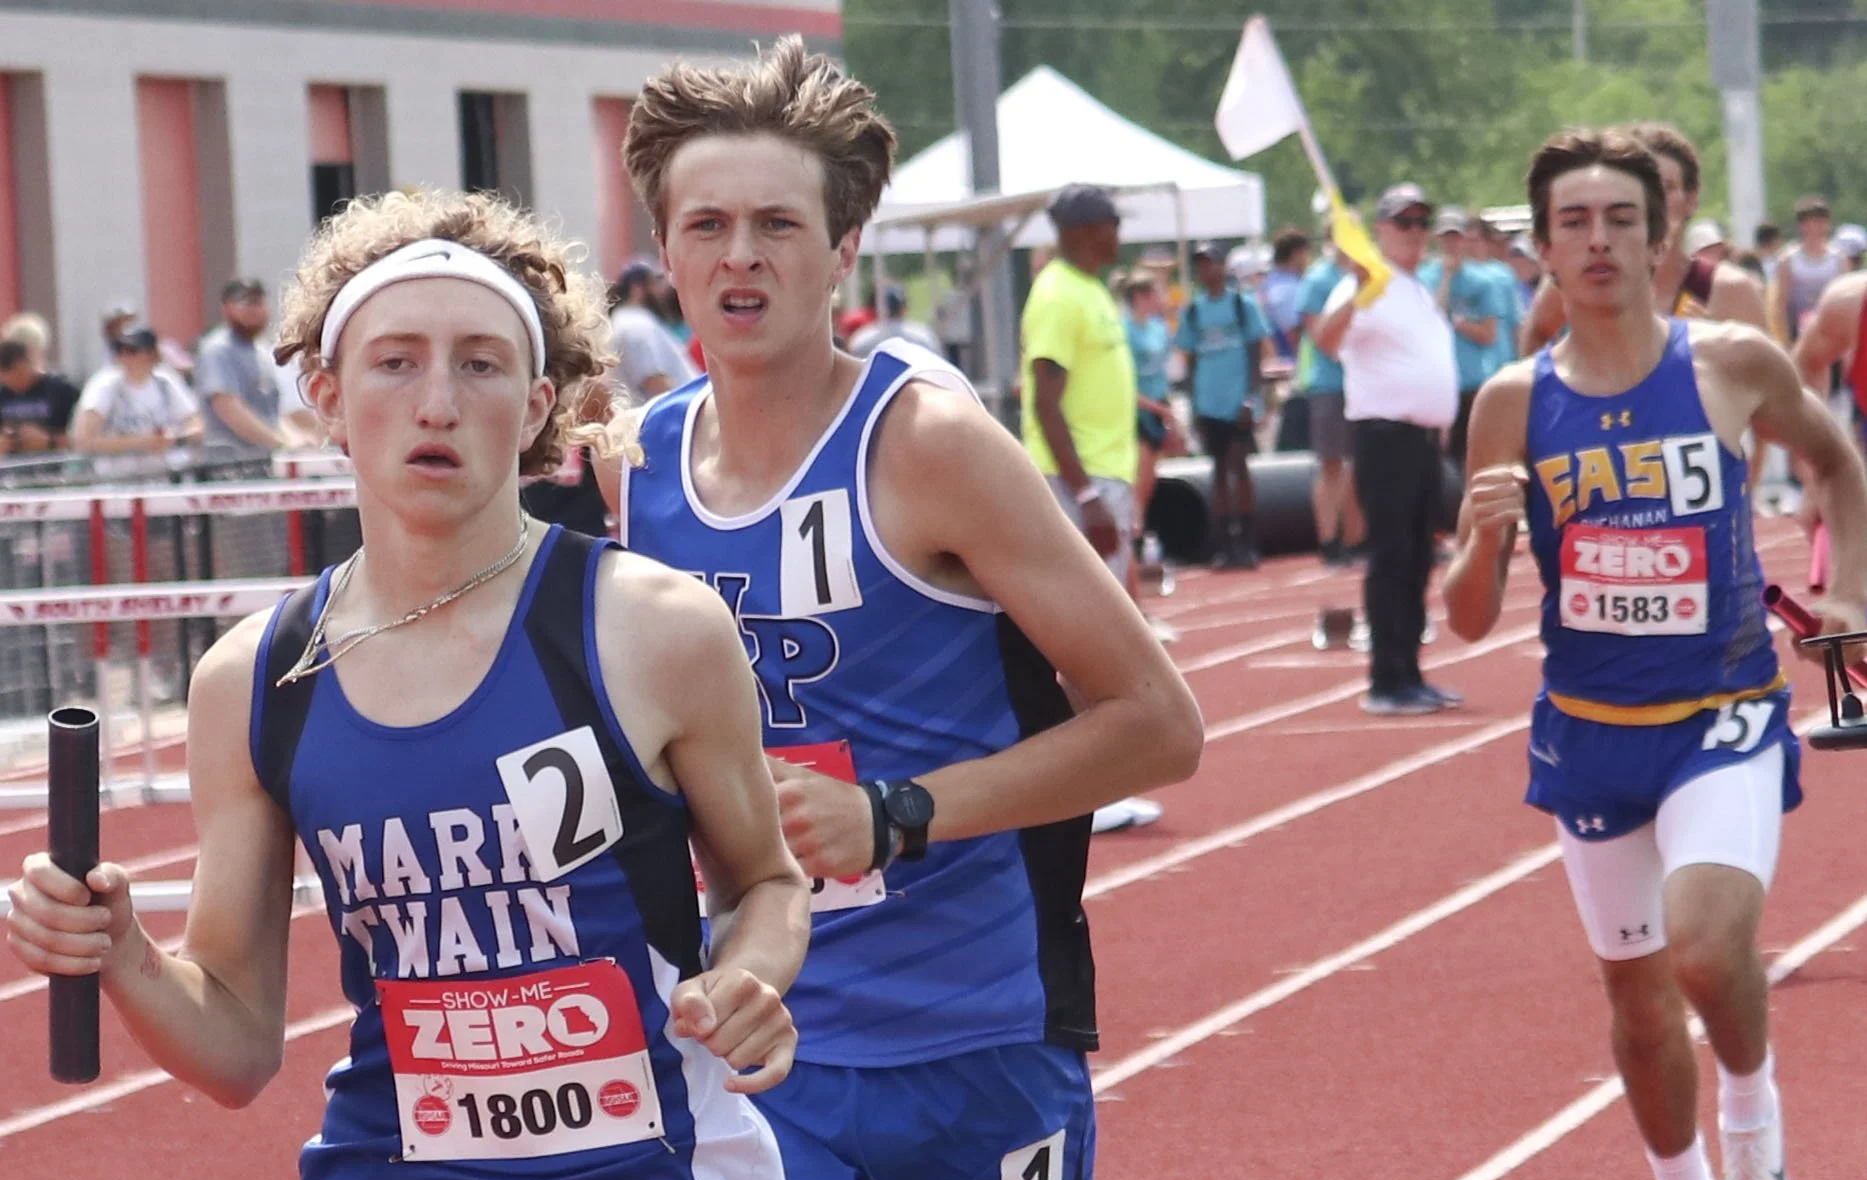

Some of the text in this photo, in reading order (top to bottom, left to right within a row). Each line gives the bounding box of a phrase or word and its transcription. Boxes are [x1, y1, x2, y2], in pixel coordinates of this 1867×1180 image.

[1535, 440, 1667, 529] EAS
[1678, 442, 1711, 508] 5
[799, 500, 832, 604] 1
[1573, 541, 1692, 577] ZERO
[1596, 594, 1668, 623] 1583
[522, 747, 607, 868] 2
[341, 885, 580, 978] TWAIN
[402, 993, 610, 1061] ZERO
[442, 981, 553, 1010] SHOW-ME
[457, 1082, 592, 1139] 1800
